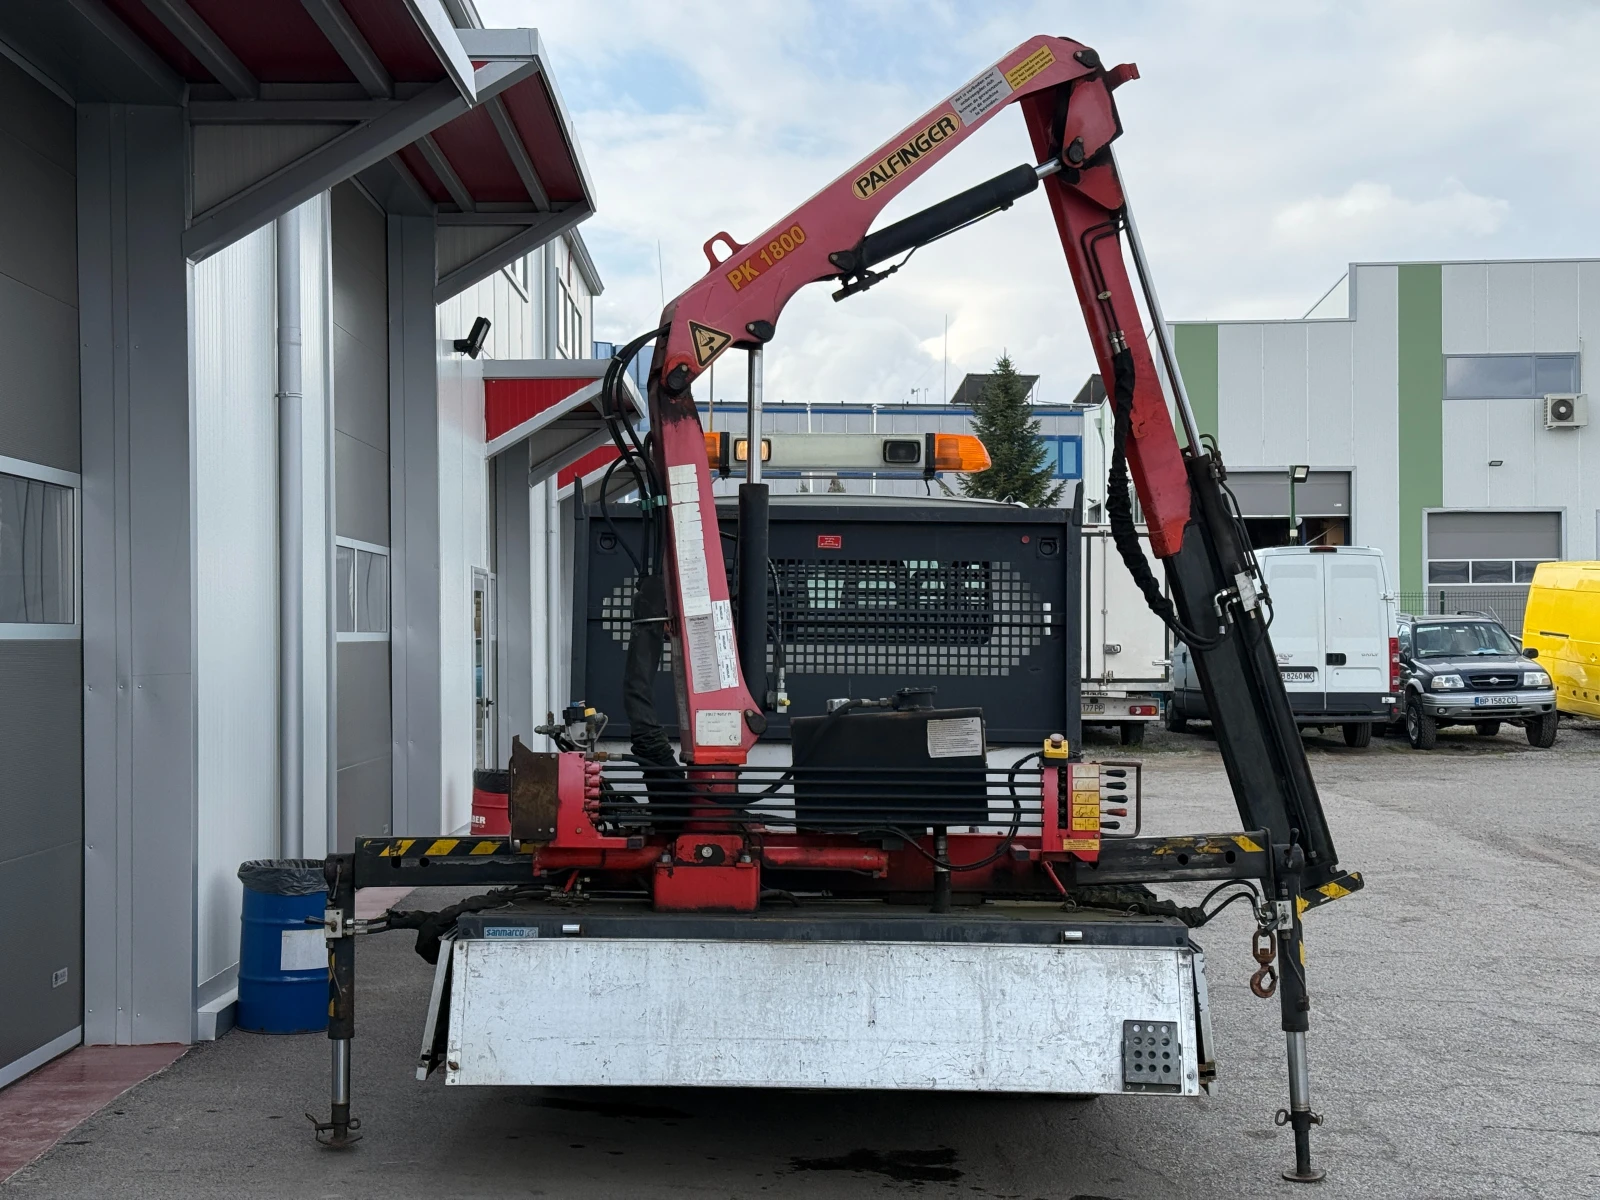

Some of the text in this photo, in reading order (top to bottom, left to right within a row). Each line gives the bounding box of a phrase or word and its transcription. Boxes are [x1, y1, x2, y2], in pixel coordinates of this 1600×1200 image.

[856, 116, 956, 197] PALFINGER
[727, 225, 807, 291] PK 1800
[1287, 672, 1303, 680] 8260
[1491, 697, 1507, 705] 1582
[1507, 696, 1516, 704] CC
[486, 929, 525, 937] sanmarco
